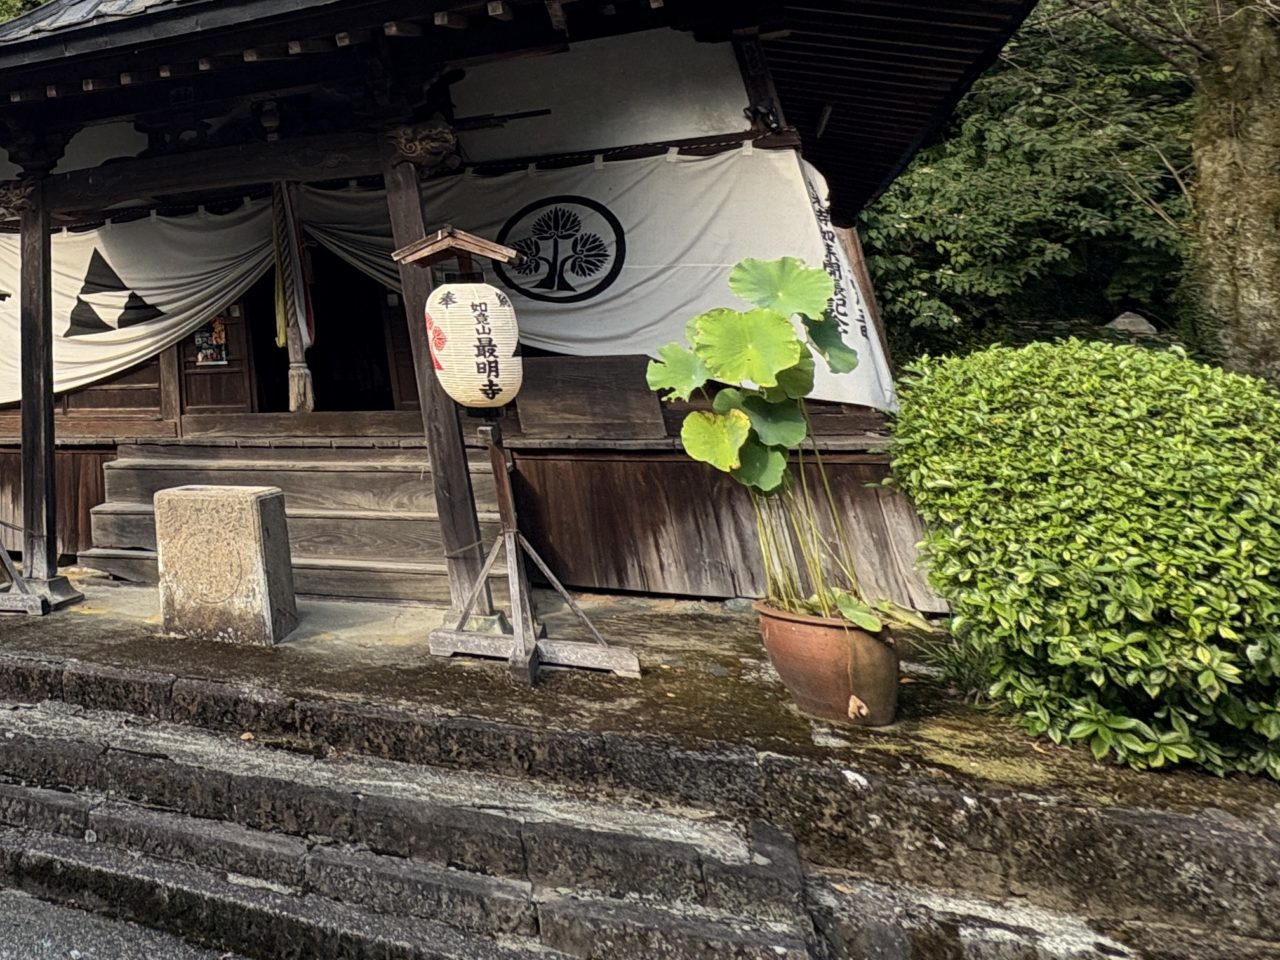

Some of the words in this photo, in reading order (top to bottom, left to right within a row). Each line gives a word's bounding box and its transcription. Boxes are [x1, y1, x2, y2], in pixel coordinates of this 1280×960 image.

[438, 291, 458, 309] 奉
[470, 301, 503, 400] 如意山最明寺
